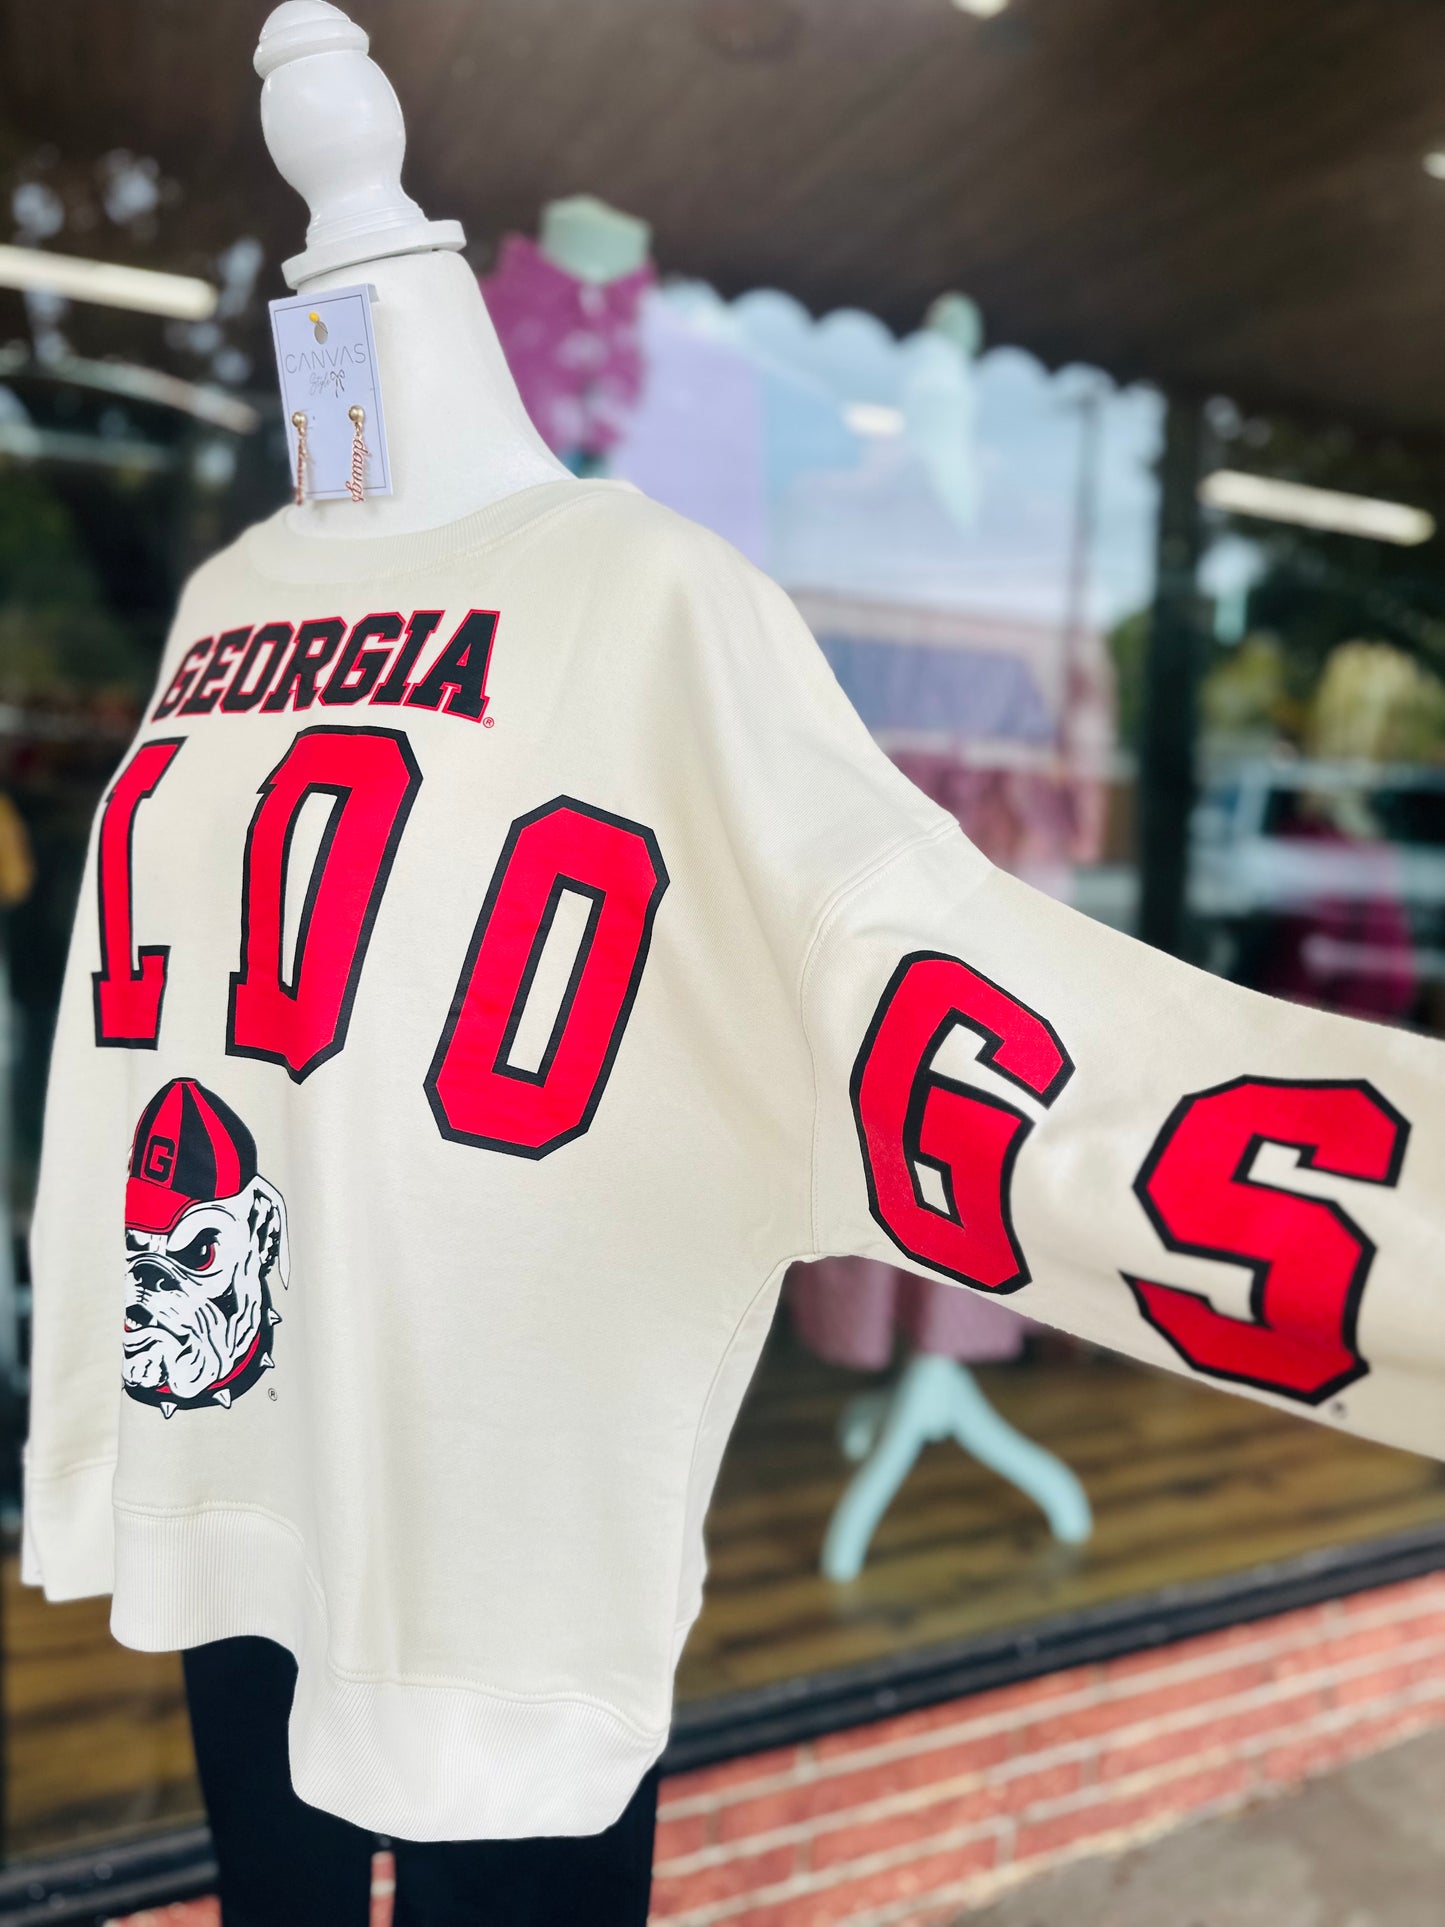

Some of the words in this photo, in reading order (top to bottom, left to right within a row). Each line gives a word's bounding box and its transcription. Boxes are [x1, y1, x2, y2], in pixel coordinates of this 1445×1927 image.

[285, 344, 367, 374] CANVAS
[150, 608, 501, 723] GEORGIA
[145, 1135, 177, 1182] G
